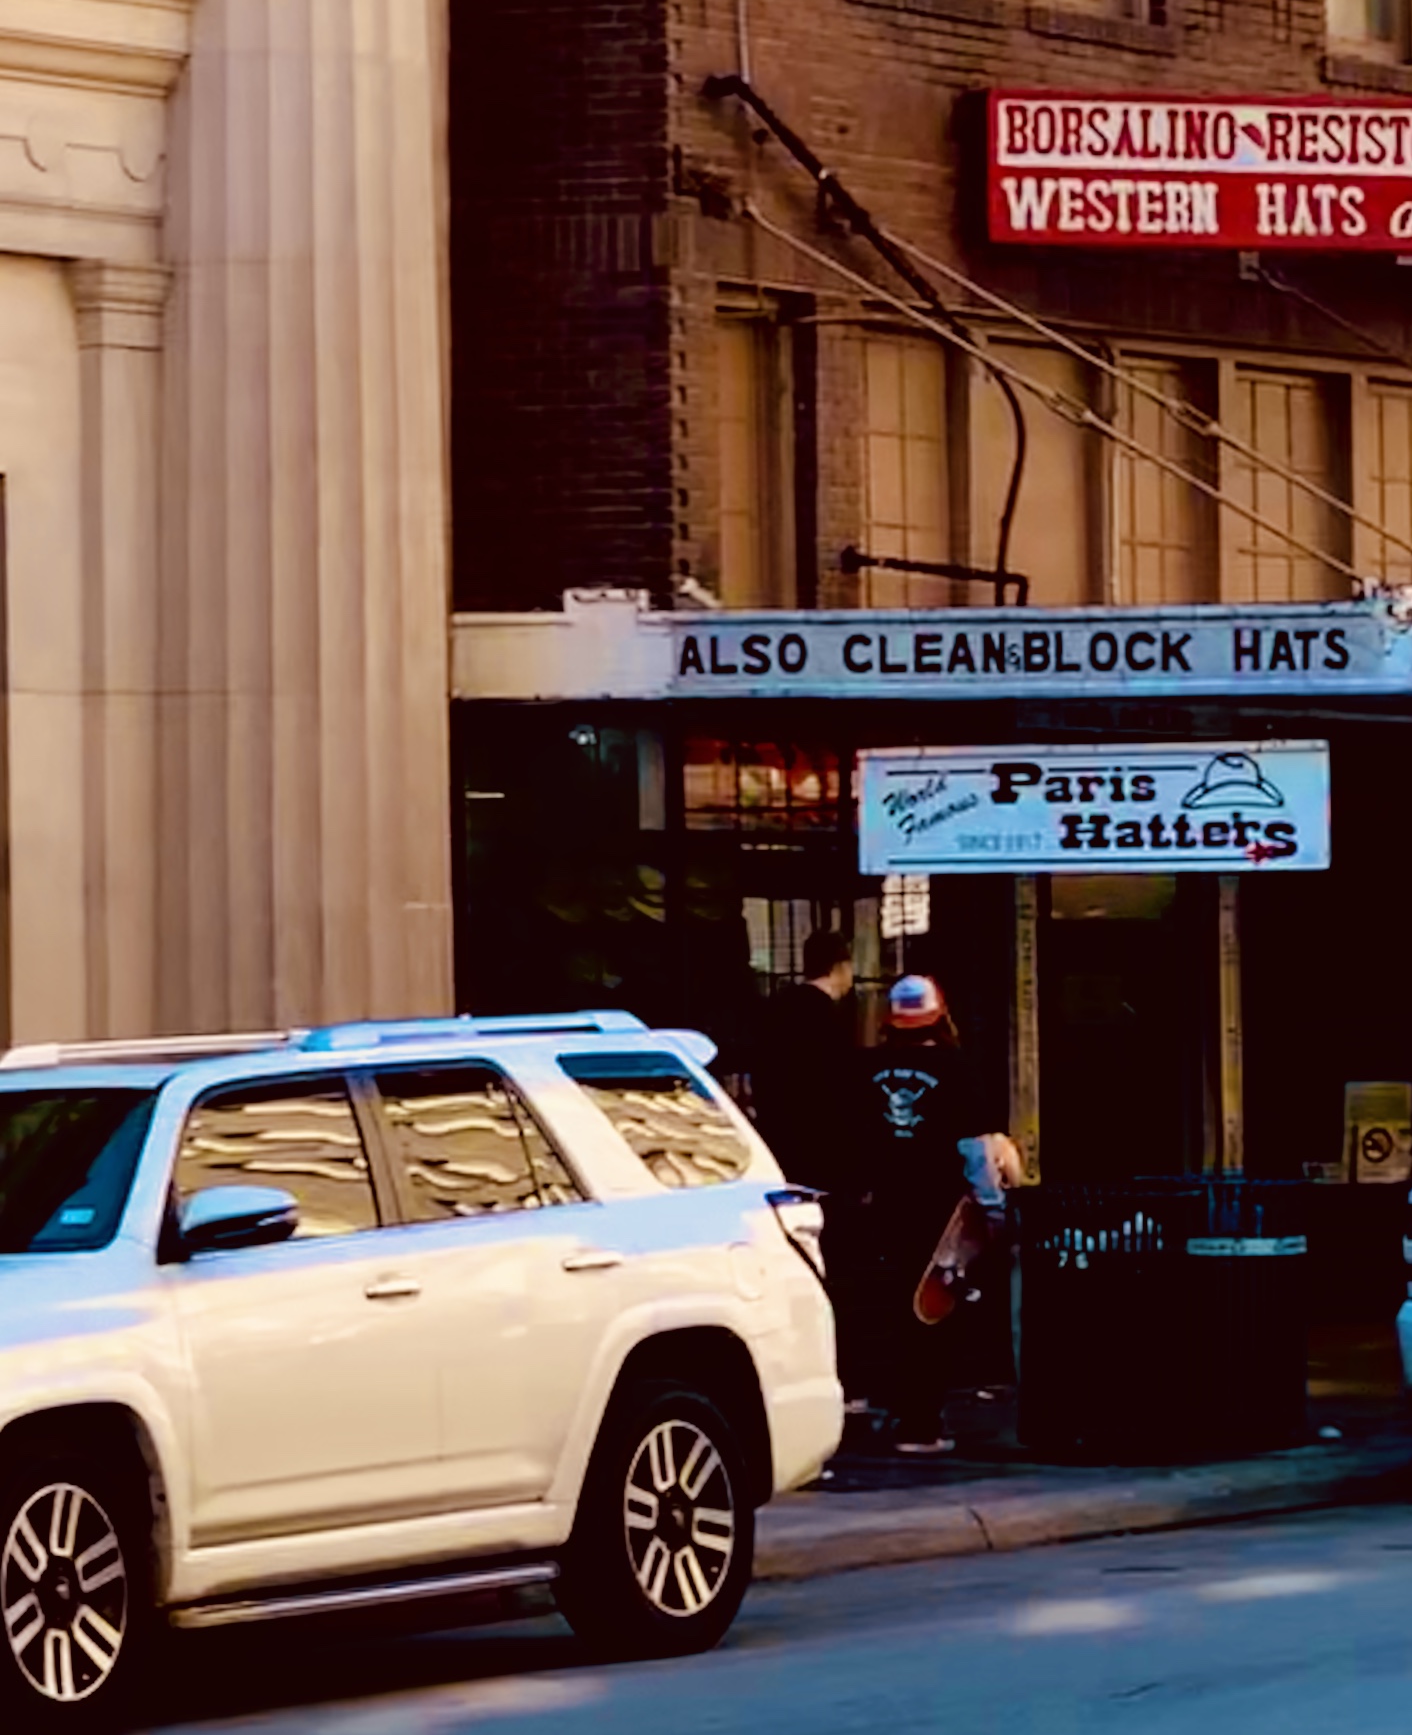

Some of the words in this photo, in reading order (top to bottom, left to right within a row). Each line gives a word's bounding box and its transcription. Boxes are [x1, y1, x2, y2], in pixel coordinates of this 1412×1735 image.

[1005, 104, 1236, 162] BORSALINO
[1002, 177, 1220, 234] WESTERN
[1256, 184, 1366, 238] HATS
[679, 633, 808, 677] ALSO
[1232, 627, 1350, 672] HATS
[990, 762, 1157, 805] Paris
[1058, 812, 1298, 862] Hatters
